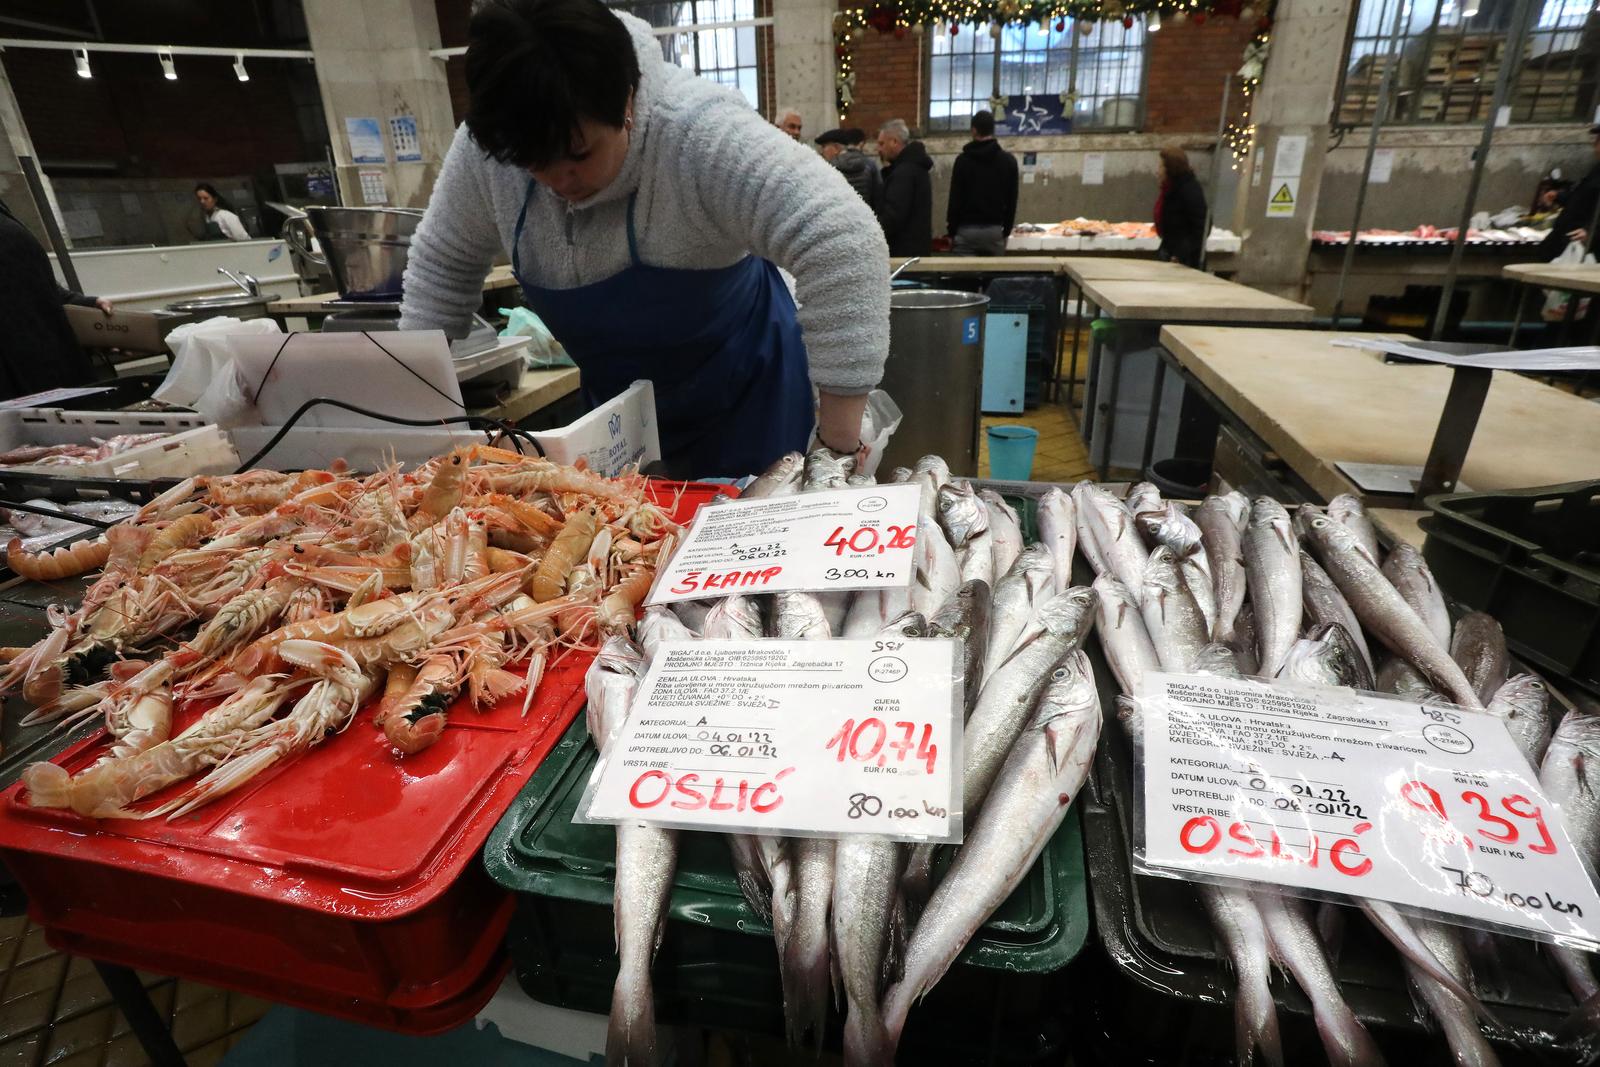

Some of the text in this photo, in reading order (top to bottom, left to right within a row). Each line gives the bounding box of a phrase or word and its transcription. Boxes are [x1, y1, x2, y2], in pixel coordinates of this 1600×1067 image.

[106, 323, 129, 332] bag
[967, 322, 976, 338] 5
[609, 438, 628, 457] ROYAL
[824, 525, 916, 556] 40,26
[670, 566, 783, 594] ŠKAMP
[1215, 693, 1240, 702] Draga
[1218, 700, 1253, 709] MJESTO
[1261, 704, 1290, 713] Tržnica
[1292, 708, 1319, 717] Rijeka
[696, 716, 707, 726] A
[1208, 713, 1241, 723] ULOVA
[1250, 718, 1291, 729] Hrvatska
[1233, 729, 1251, 738] FAO
[1244, 725, 1268, 733] moru
[1333, 736, 1374, 747] mrežom
[1376, 742, 1427, 755] plivaricom
[825, 718, 937, 774] 10,74
[1271, 741, 1286, 749] DO
[1282, 749, 1318, 760] SVJEŽA
[1171, 772, 1205, 782] DATUM
[1454, 776, 1468, 784] KN
[629, 766, 796, 813] OSLIĆ
[1172, 803, 1231, 818] VRSTA RIBE
[1180, 815, 1373, 876] OSLIĆ
[1479, 845, 1502, 855] EUR
[1509, 851, 1525, 860] KG
[1545, 892, 1583, 918] kn
